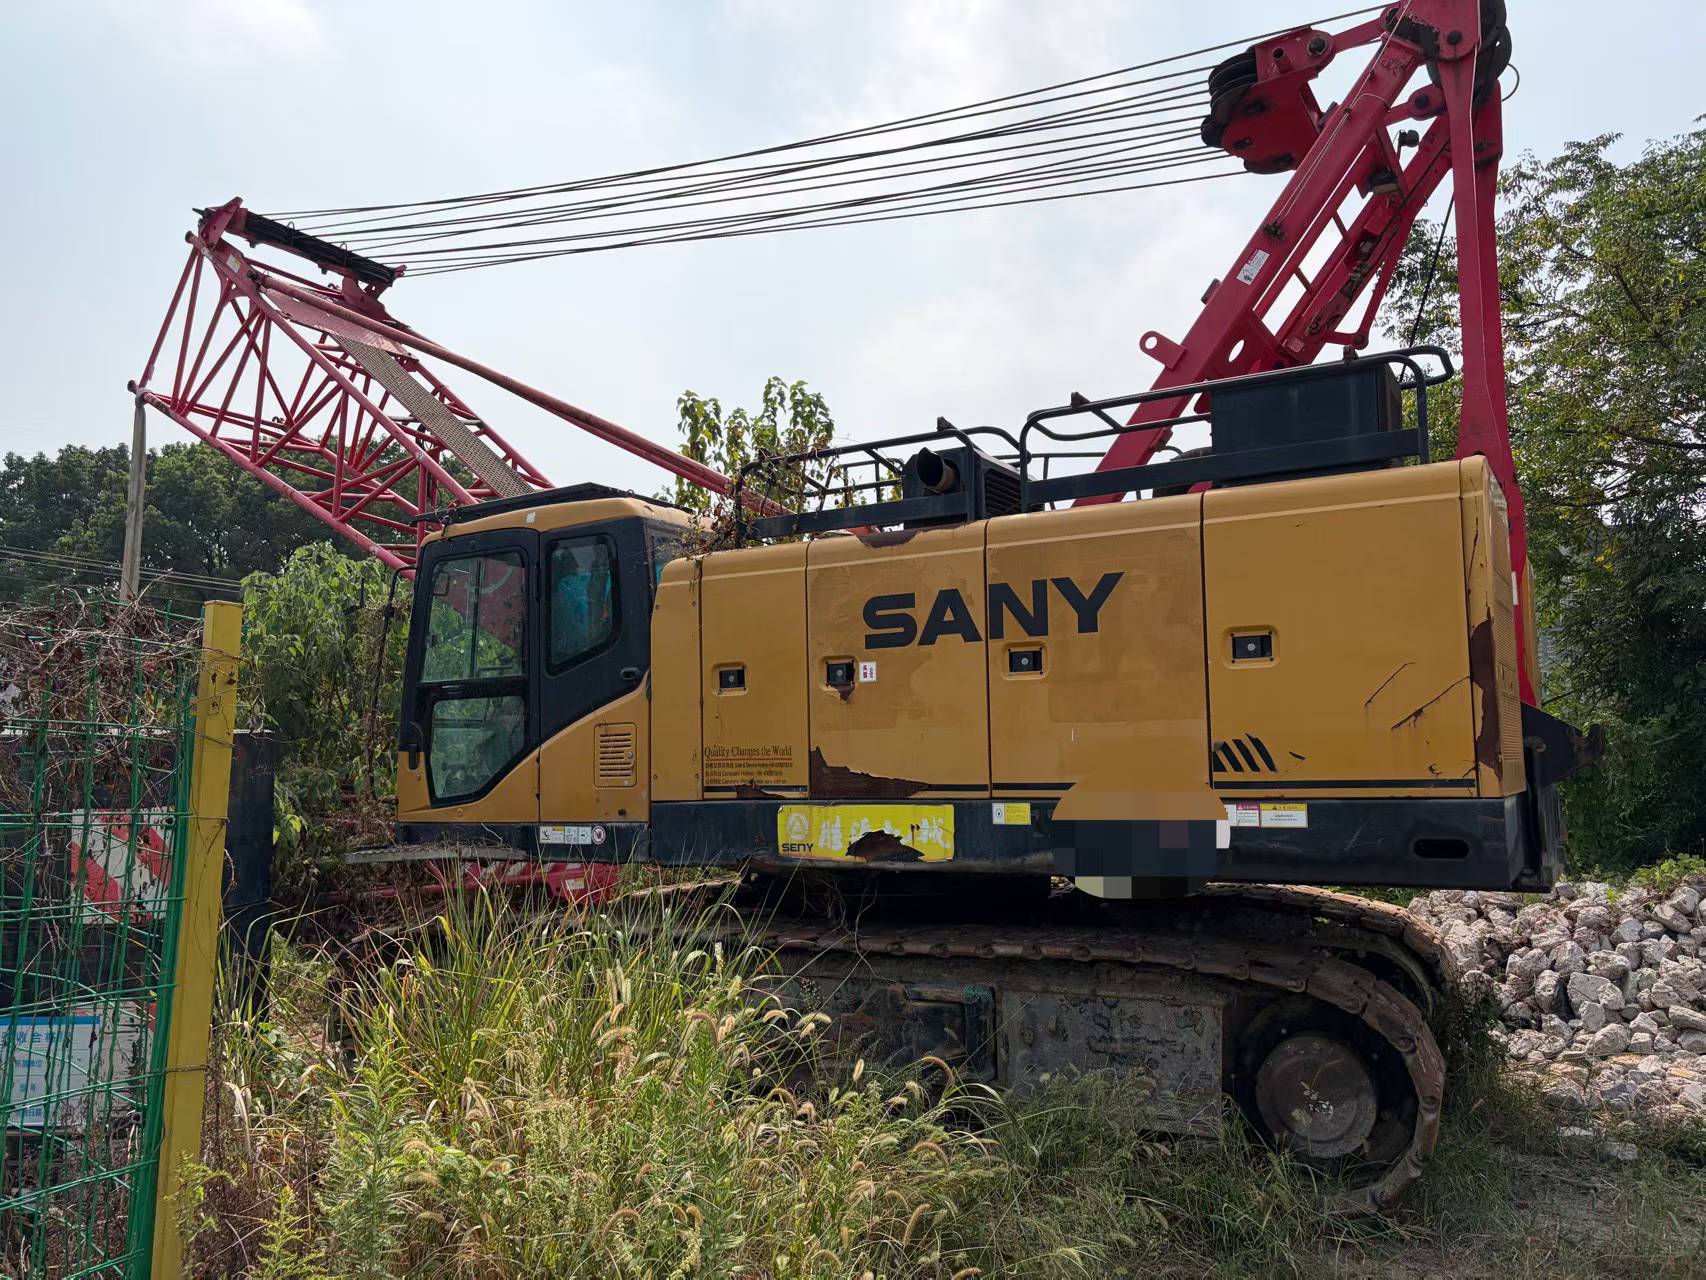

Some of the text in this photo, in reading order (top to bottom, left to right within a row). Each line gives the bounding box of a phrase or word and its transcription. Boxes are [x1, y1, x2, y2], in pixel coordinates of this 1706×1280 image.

[862, 571, 1125, 650] SANY
[704, 745, 792, 759] Quality Changes the World
